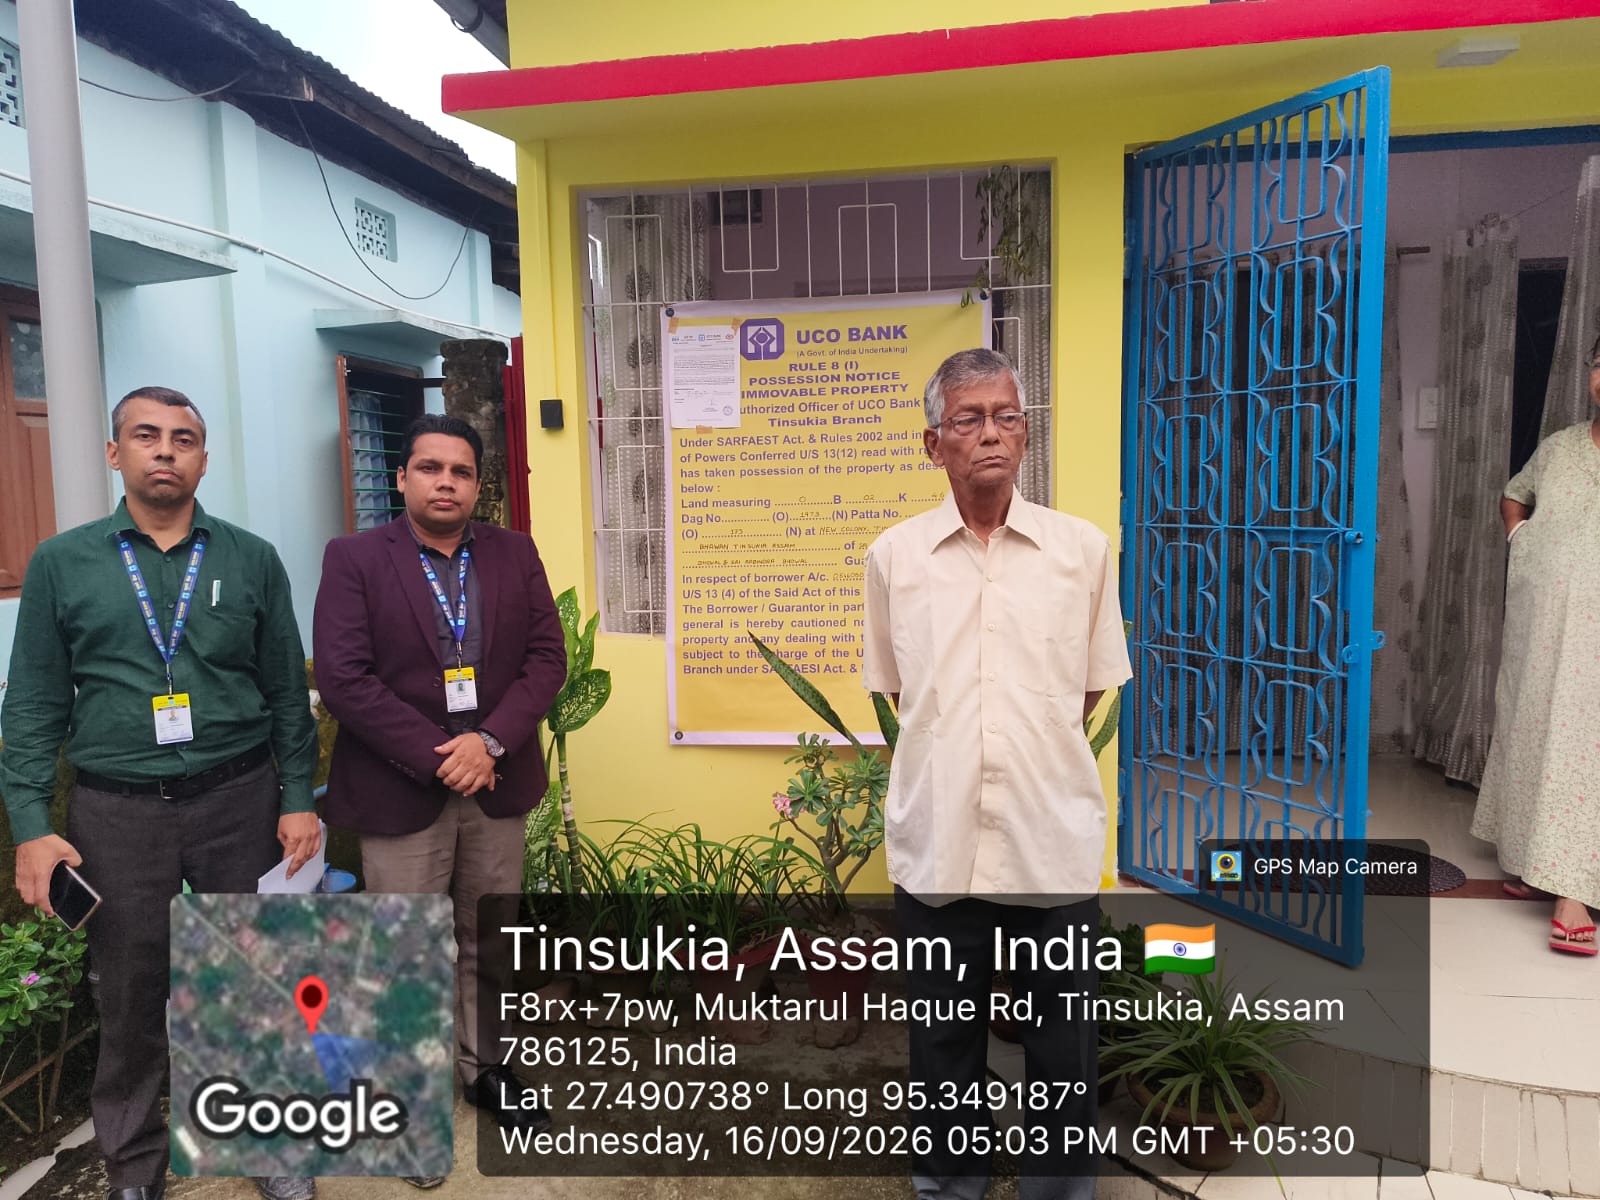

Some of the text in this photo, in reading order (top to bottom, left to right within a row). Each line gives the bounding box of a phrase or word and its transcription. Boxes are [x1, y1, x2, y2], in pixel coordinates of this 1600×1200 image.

[797, 324, 908, 344] UCO BANK
[829, 348, 836, 356] of
[838, 347, 856, 356] India
[858, 346, 908, 354] Undertaking)
[789, 360, 858, 372] RULE 8 (I)
[750, 372, 900, 386] POSSESSION NOTICE
[741, 388, 826, 399] IMMOVABLE
[832, 384, 908, 396] PROPERTY
[740, 402, 794, 414] uthorized
[798, 402, 838, 412] Officer
[842, 400, 854, 410] of
[858, 398, 886, 410] UCO
[890, 398, 920, 408] Bank
[768, 414, 882, 428] Tinsukia Branch
[680, 430, 922, 448] Under SARFAEST Act. & Rules 2002 and in
[680, 453, 691, 462] of
[695, 453, 736, 462] Powers
[740, 450, 796, 461] Conferred
[800, 448, 819, 460] U/S
[824, 448, 857, 460] 13(12)
[862, 446, 886, 457] read
[890, 446, 914, 456] with
[680, 469, 700, 478] has
[705, 468, 735, 478] taken
[740, 466, 804, 478] possession
[808, 464, 820, 475] of
[824, 464, 842, 474] the
[846, 463, 895, 476] property
[900, 462, 912, 472] as
[680, 484, 714, 494] below
[681, 498, 709, 508] Land
[712, 498, 771, 508] measuring
[833, 494, 842, 504] B
[898, 492, 908, 502] K
[682, 514, 703, 525] Dag
[772, 512, 789, 523] (O)
[832, 510, 848, 521] (N)
[851, 508, 880, 520] Patta
[682, 528, 698, 540] (O)
[785, 526, 802, 538] (N)
[805, 527, 816, 536] at
[844, 540, 856, 550] of
[682, 574, 692, 584] In
[696, 574, 737, 585] respect
[740, 574, 751, 583] of
[754, 573, 804, 582] borrower
[682, 587, 860, 600] U/S 13 (4) of the Said Act of this
[683, 604, 703, 614] The
[706, 604, 758, 614] Borrower
[768, 602, 825, 612] Guarantor
[829, 602, 839, 612] in
[844, 602, 864, 614] part
[683, 619, 724, 631] general
[730, 620, 740, 628] is
[746, 618, 784, 630] hereby
[790, 618, 846, 628] cautioned
[683, 635, 729, 646] property
[760, 636, 780, 646] any
[786, 634, 826, 644] dealing
[832, 633, 855, 642] with
[683, 650, 724, 660] subject
[729, 650, 740, 659] to
[746, 650, 764, 659] the
[776, 648, 808, 660] harge
[814, 648, 826, 658] of
[832, 648, 850, 658] the
[684, 664, 722, 674] Branch
[726, 664, 758, 674] under
[762, 664, 820, 674] SAAESI
[850, 664, 858, 673] &
